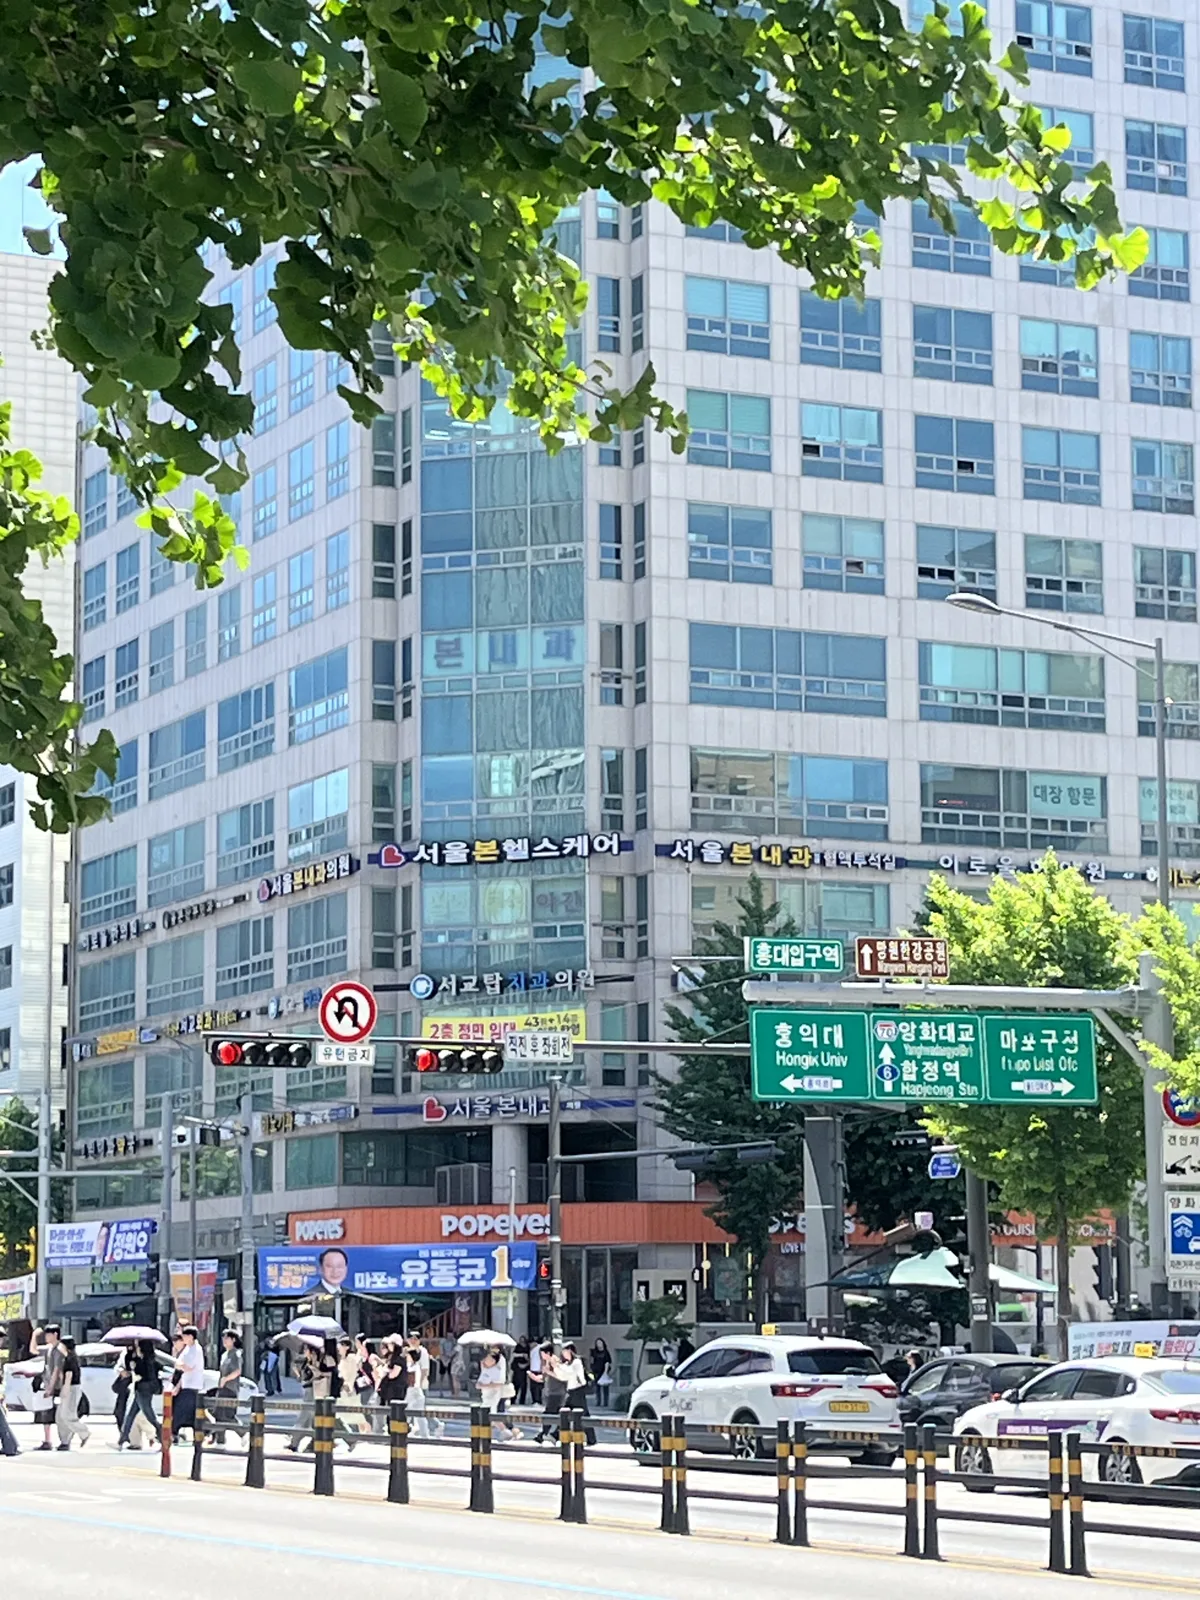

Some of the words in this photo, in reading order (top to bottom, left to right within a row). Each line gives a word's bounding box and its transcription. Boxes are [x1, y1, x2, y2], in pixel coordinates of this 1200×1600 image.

[1033, 785, 1063, 804] 대장
[1067, 787, 1096, 806] 항문
[412, 832, 620, 865] 서울본헬스케어
[671, 840, 812, 868] 서울본내과
[271, 854, 350, 896] 서울본내과의원
[755, 941, 839, 967] 홍대입구역
[876, 940, 946, 961] 망원한강공원
[429, 1023, 455, 1040] 2층
[458, 1022, 485, 1040] 정면
[880, 1027, 894, 1039] 70
[899, 1021, 976, 1044] 양화대교
[322, 1046, 370, 1061] 유턴금지
[776, 1050, 819, 1070] Hongik
[821, 1051, 848, 1067] Univ
[883, 1066, 891, 1080] 6
[900, 1060, 961, 1082] 합정역
[901, 1082, 954, 1098] Hapjeong
[354, 1271, 398, 1289] 마포는
[401, 1258, 487, 1288] 유동균
[490, 1245, 512, 1287] 1
